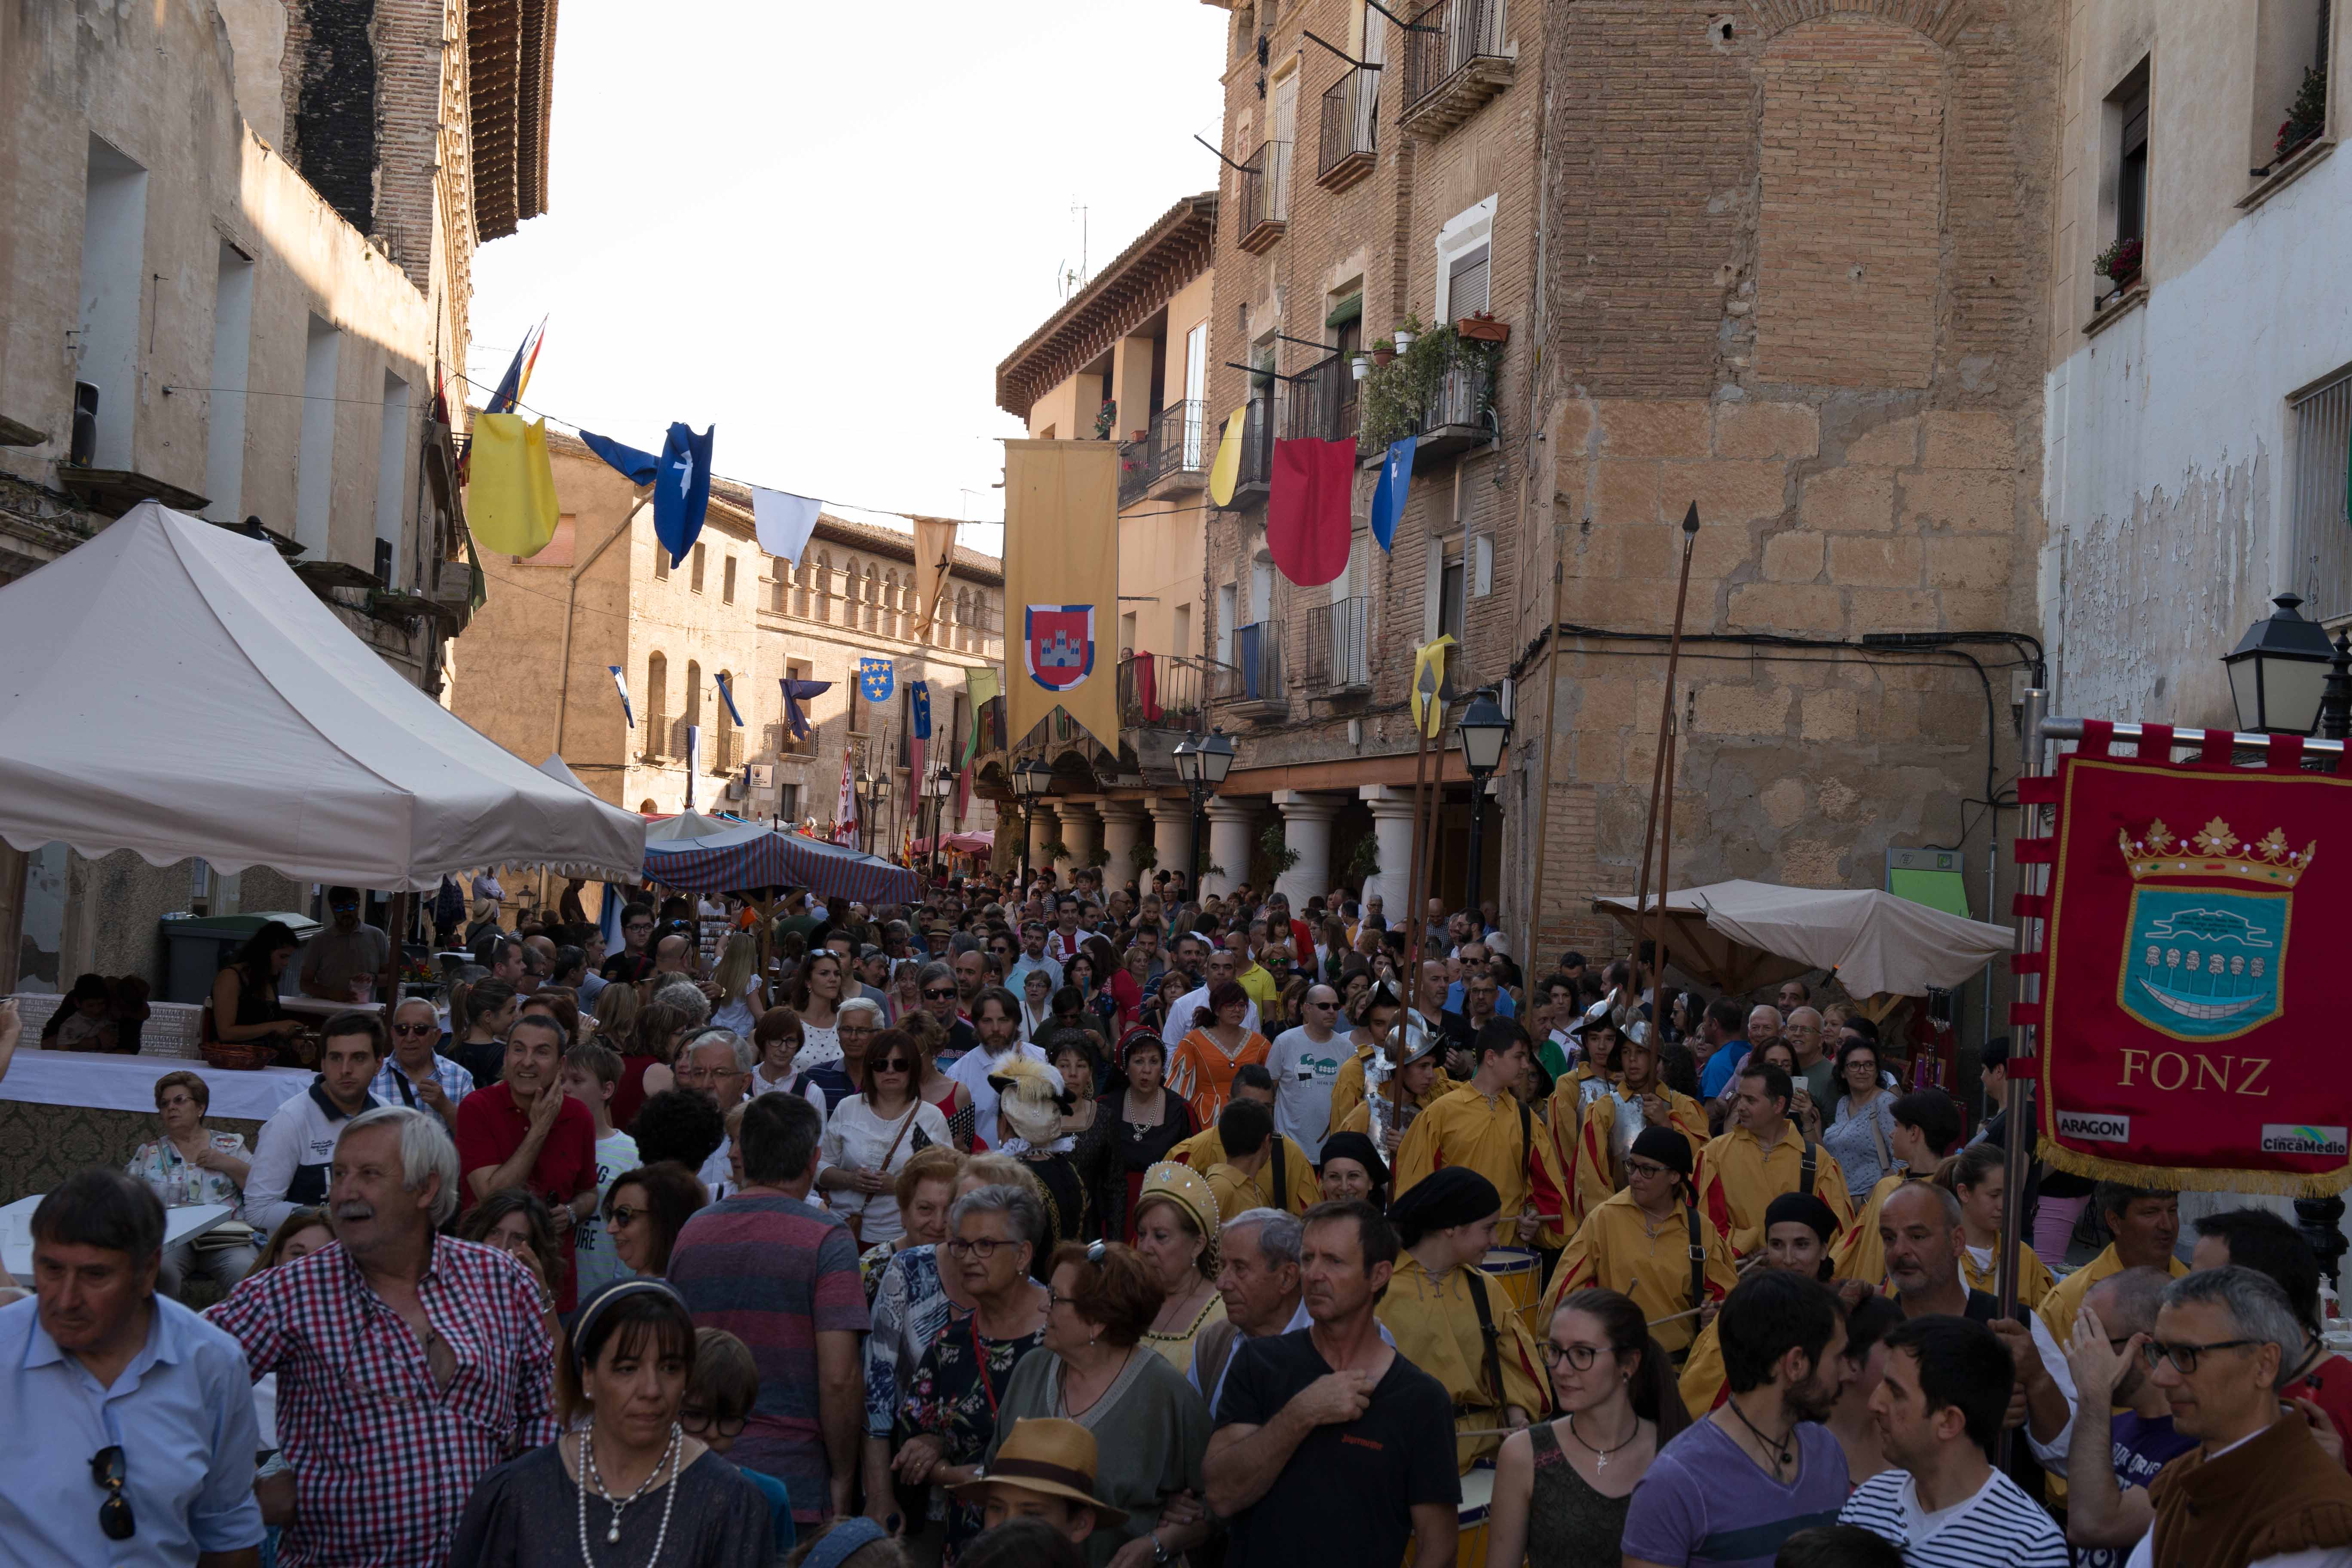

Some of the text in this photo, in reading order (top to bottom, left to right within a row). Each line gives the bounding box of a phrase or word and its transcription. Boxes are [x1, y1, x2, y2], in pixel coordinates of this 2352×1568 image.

[2116, 1048, 2272, 1096] FONZ
[2061, 1118, 2124, 1136] ARAGON
[2263, 1138, 2345, 1153] CincaMedio
